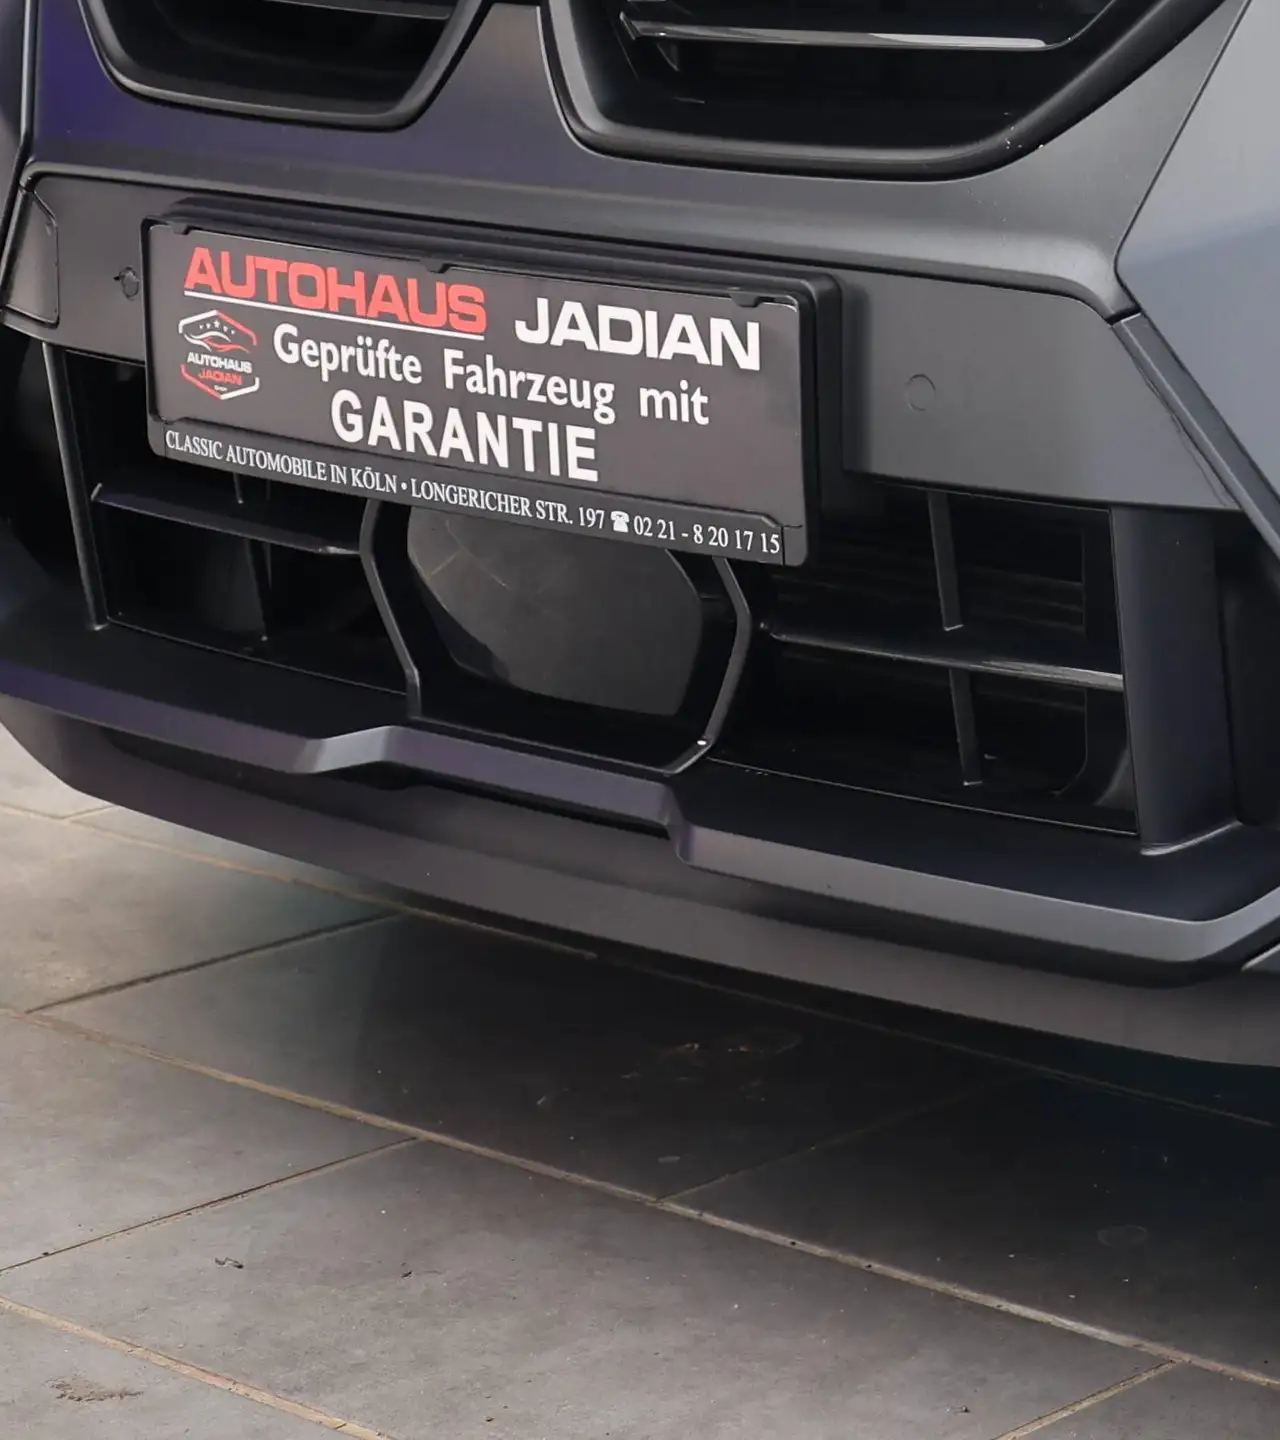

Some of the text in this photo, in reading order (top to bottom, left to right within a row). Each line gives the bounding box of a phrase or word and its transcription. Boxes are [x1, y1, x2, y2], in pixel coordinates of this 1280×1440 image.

[184, 247, 762, 371] AUTOHAUS JADIAN
[187, 352, 253, 374] AUTOHAUS
[273, 323, 710, 427] Geprüfte Fahrzeug mit
[330, 390, 599, 483] GARANTIE
[165, 430, 224, 460] CLASSIC
[226, 444, 328, 481] AUTOMOBILE
[330, 464, 347, 485] IN
[351, 466, 398, 493] KÖLN
[411, 478, 533, 517] LONGERICHER
[536, 499, 574, 525] STR.
[579, 506, 605, 529] 197
[633, 515, 653, 537] 02
[657, 519, 676, 540] 21
[692, 524, 704, 544] 8
[707, 526, 729, 548] 20
[735, 529, 754, 551] 17
[760, 532, 781, 554] 15
